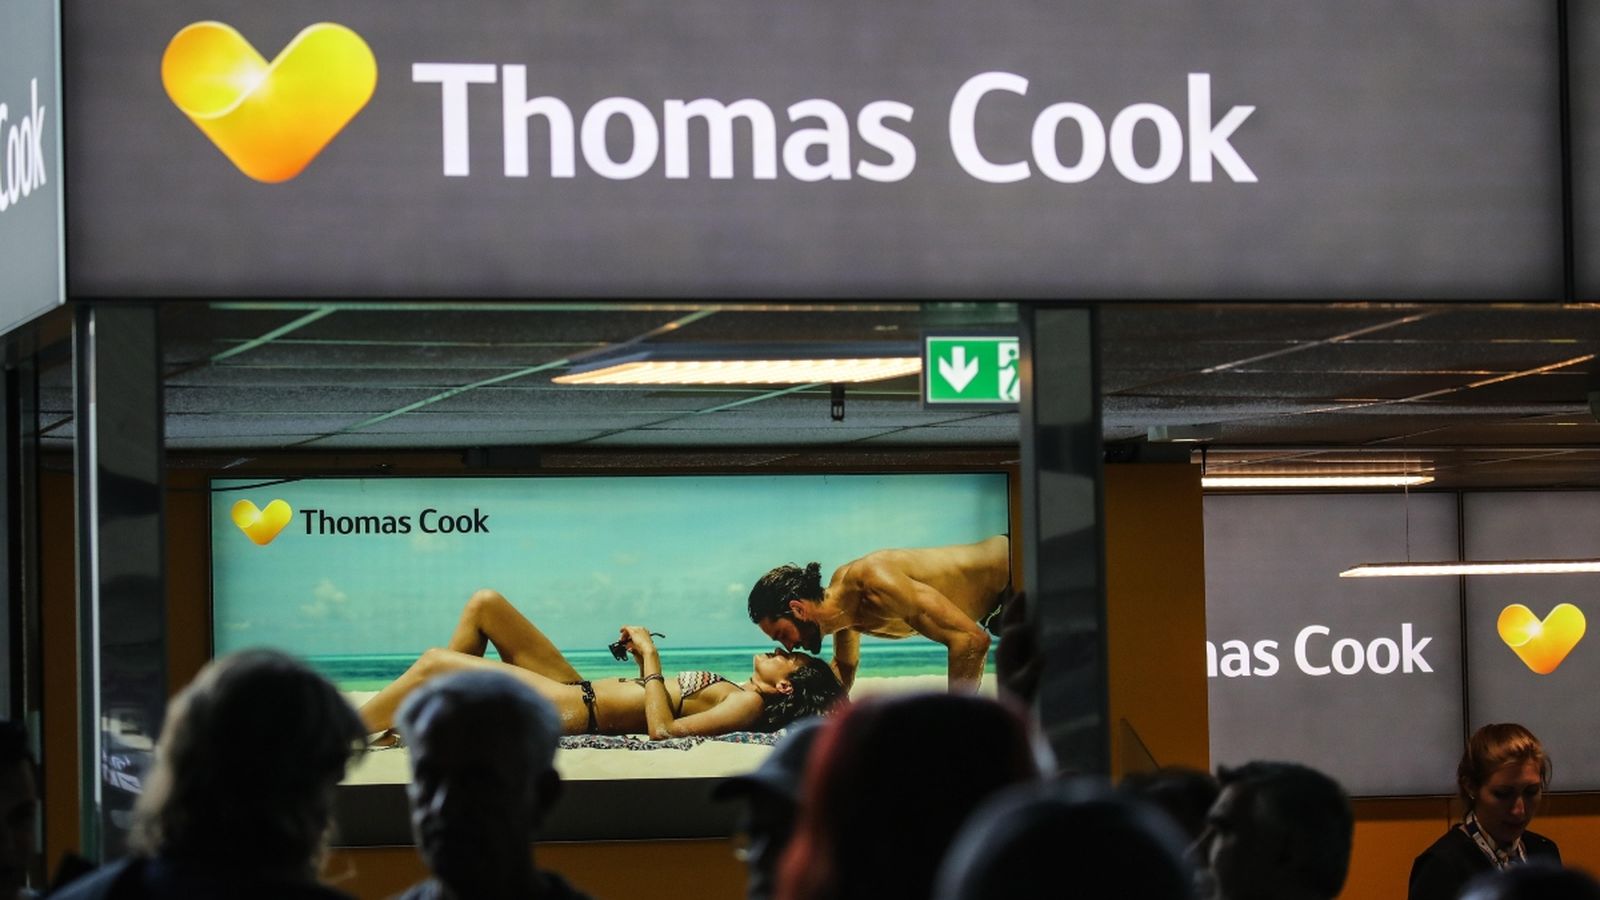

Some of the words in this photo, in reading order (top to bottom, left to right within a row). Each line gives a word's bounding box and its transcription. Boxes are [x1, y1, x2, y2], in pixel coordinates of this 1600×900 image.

[411, 62, 916, 183] Thomas
[948, 71, 1259, 185] Cook
[299, 508, 412, 535] Thomas
[419, 507, 491, 534] Cook
[1293, 622, 1434, 677] Cook
